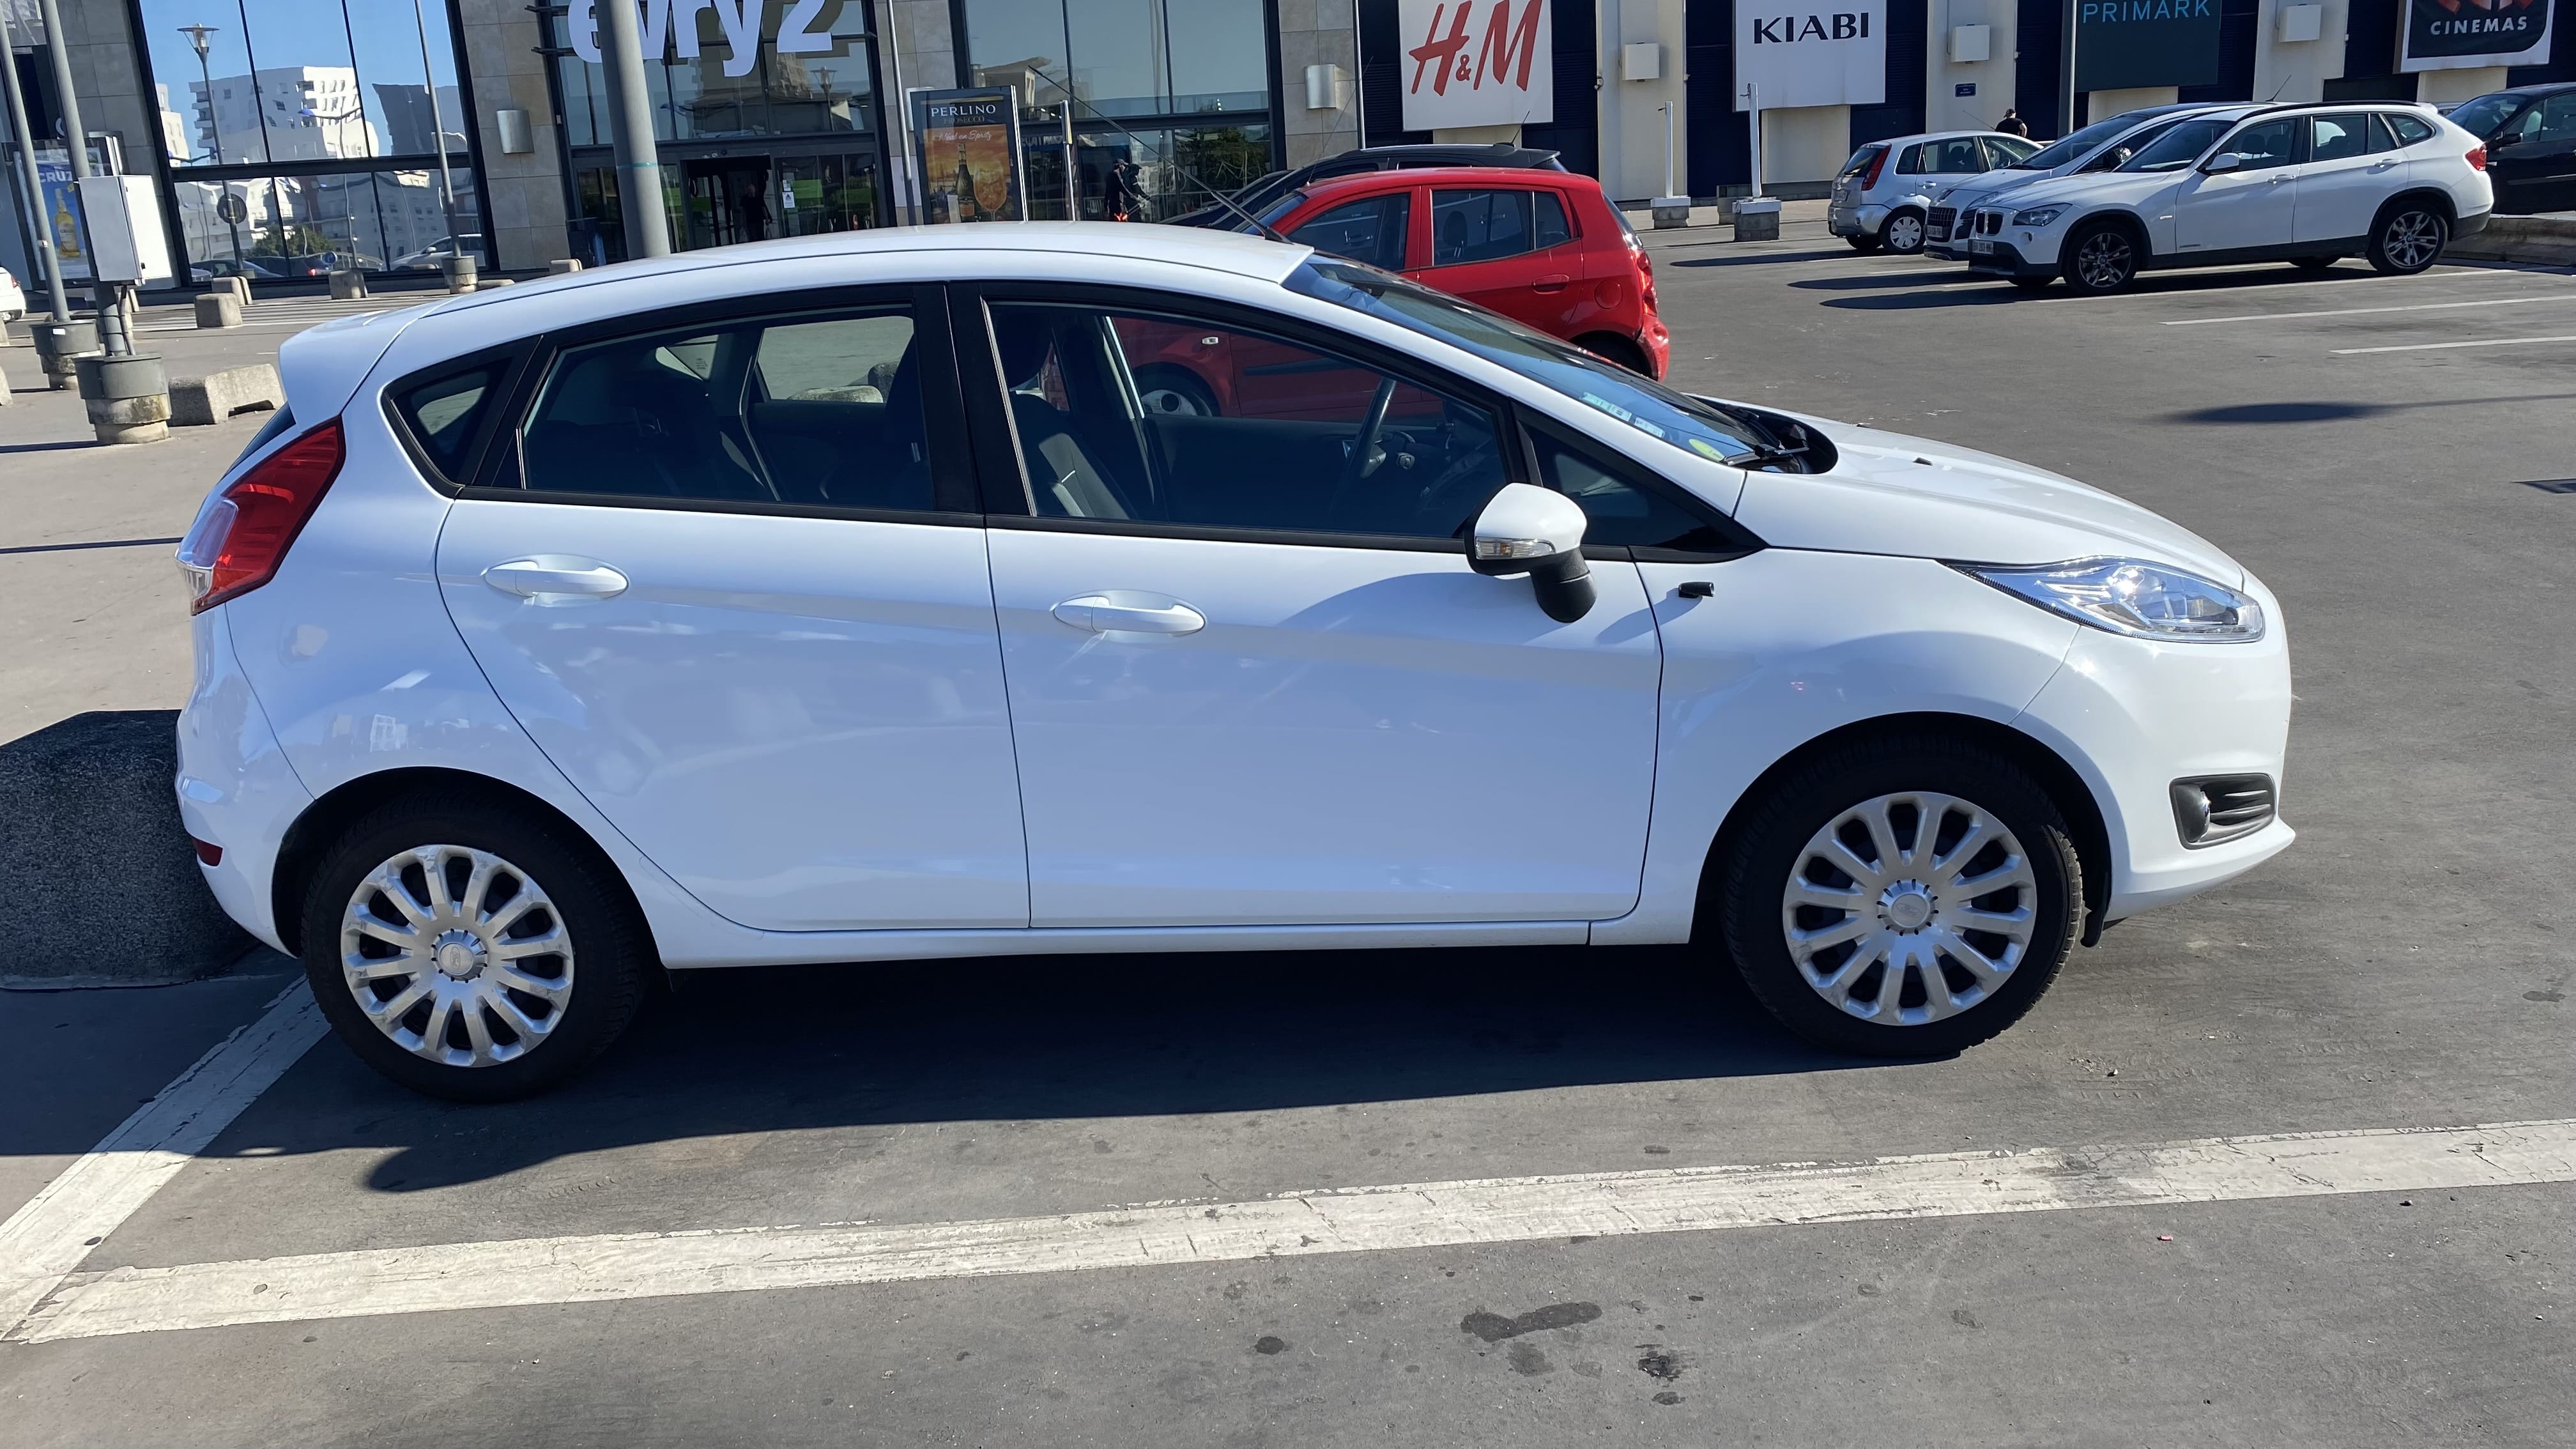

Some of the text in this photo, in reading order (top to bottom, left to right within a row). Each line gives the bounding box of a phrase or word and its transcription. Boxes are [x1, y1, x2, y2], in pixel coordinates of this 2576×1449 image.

[2083, 0, 2210, 24] PRIMARK
[1754, 12, 1869, 44] KIABI
[2430, 16, 2527, 35] CINEMAS
[1409, 0, 1542, 96] H&M
[931, 104, 996, 117] PERLINO
[944, 115, 985, 124] PROSECCO
[969, 130, 992, 141] Spritz
